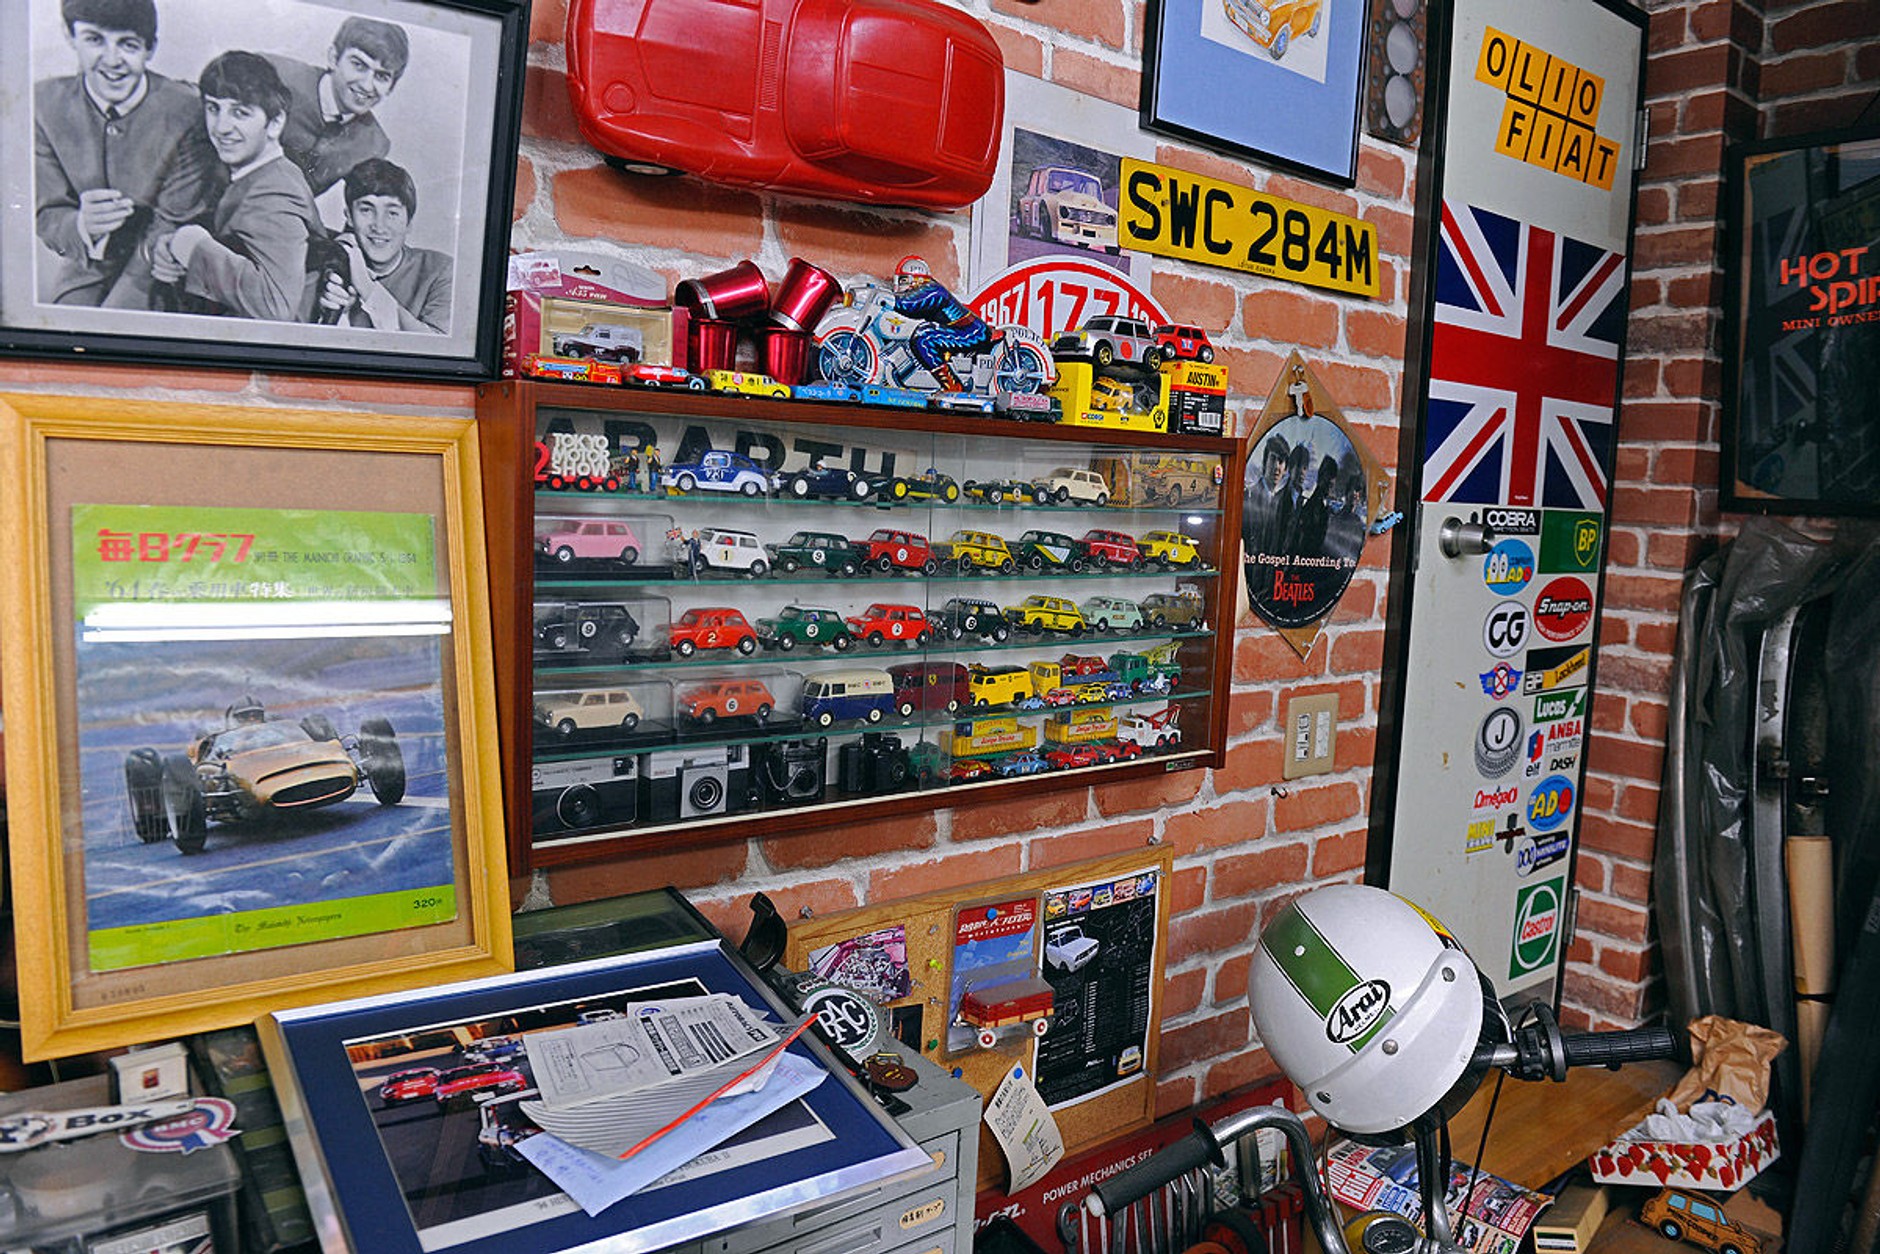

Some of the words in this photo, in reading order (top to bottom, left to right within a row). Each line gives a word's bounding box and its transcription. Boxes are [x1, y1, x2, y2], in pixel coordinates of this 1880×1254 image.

[1486, 37, 1597, 116] OLIO
[1506, 111, 1614, 181] FIAT
[1127, 170, 1236, 255] SWC
[1247, 200, 1372, 287] 284M
[1781, 247, 1869, 288] HOT
[979, 281, 1026, 326] 1967
[1782, 318, 1821, 331] MINI
[1827, 311, 1880, 327] OWNE
[1186, 371, 1216, 387] AUSTIN
[552, 432, 609, 449] TOKYO
[552, 449, 610, 463] MOTOR
[552, 461, 611, 477] SHOW
[1487, 510, 1537, 527] COBRA
[97, 529, 256, 563] 毎日グラフ
[1578, 528, 1596, 551] BP
[1244, 552, 1255, 564] he
[1258, 552, 1290, 568] Gospel
[1292, 555, 1342, 570] According
[1273, 570, 1315, 608] BEATLES
[1538, 598, 1588, 617] Snap-on
[1548, 720, 1582, 741] ANSA
[1521, 911, 1556, 941] Castrol
[818, 1000, 866, 1044] RAC
[1336, 981, 1383, 1041] Arai
[1043, 1179, 1079, 1205] POWER
[1080, 1155, 1136, 1188] MECHANICS
